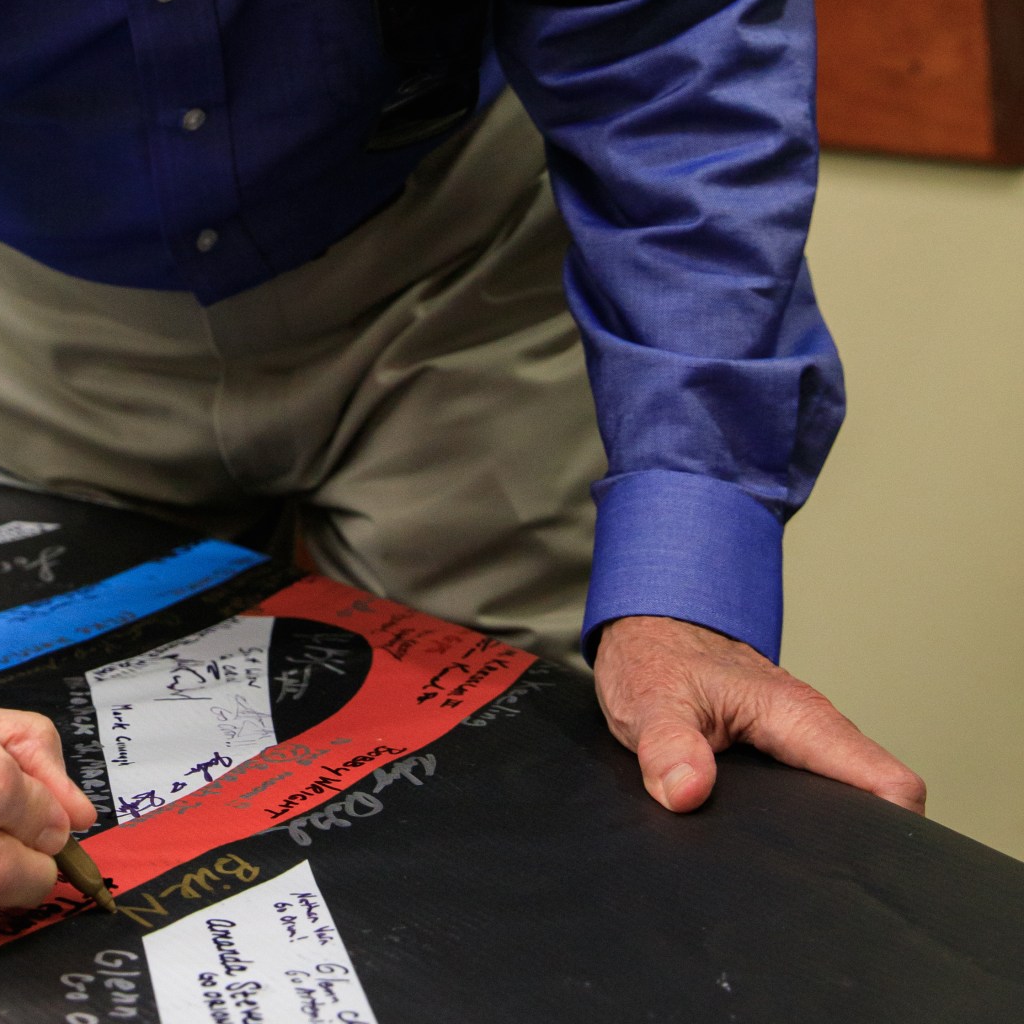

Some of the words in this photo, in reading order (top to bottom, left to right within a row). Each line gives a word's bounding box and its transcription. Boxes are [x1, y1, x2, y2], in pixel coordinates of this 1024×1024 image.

[111, 703, 134, 731] Mark
[321, 745, 407, 777] BOBBY
[264, 775, 342, 819] WRIGHT
[205, 918, 255, 977] Amanda
[59, 972, 95, 1003] Go
[93, 949, 142, 1019] Glenn
